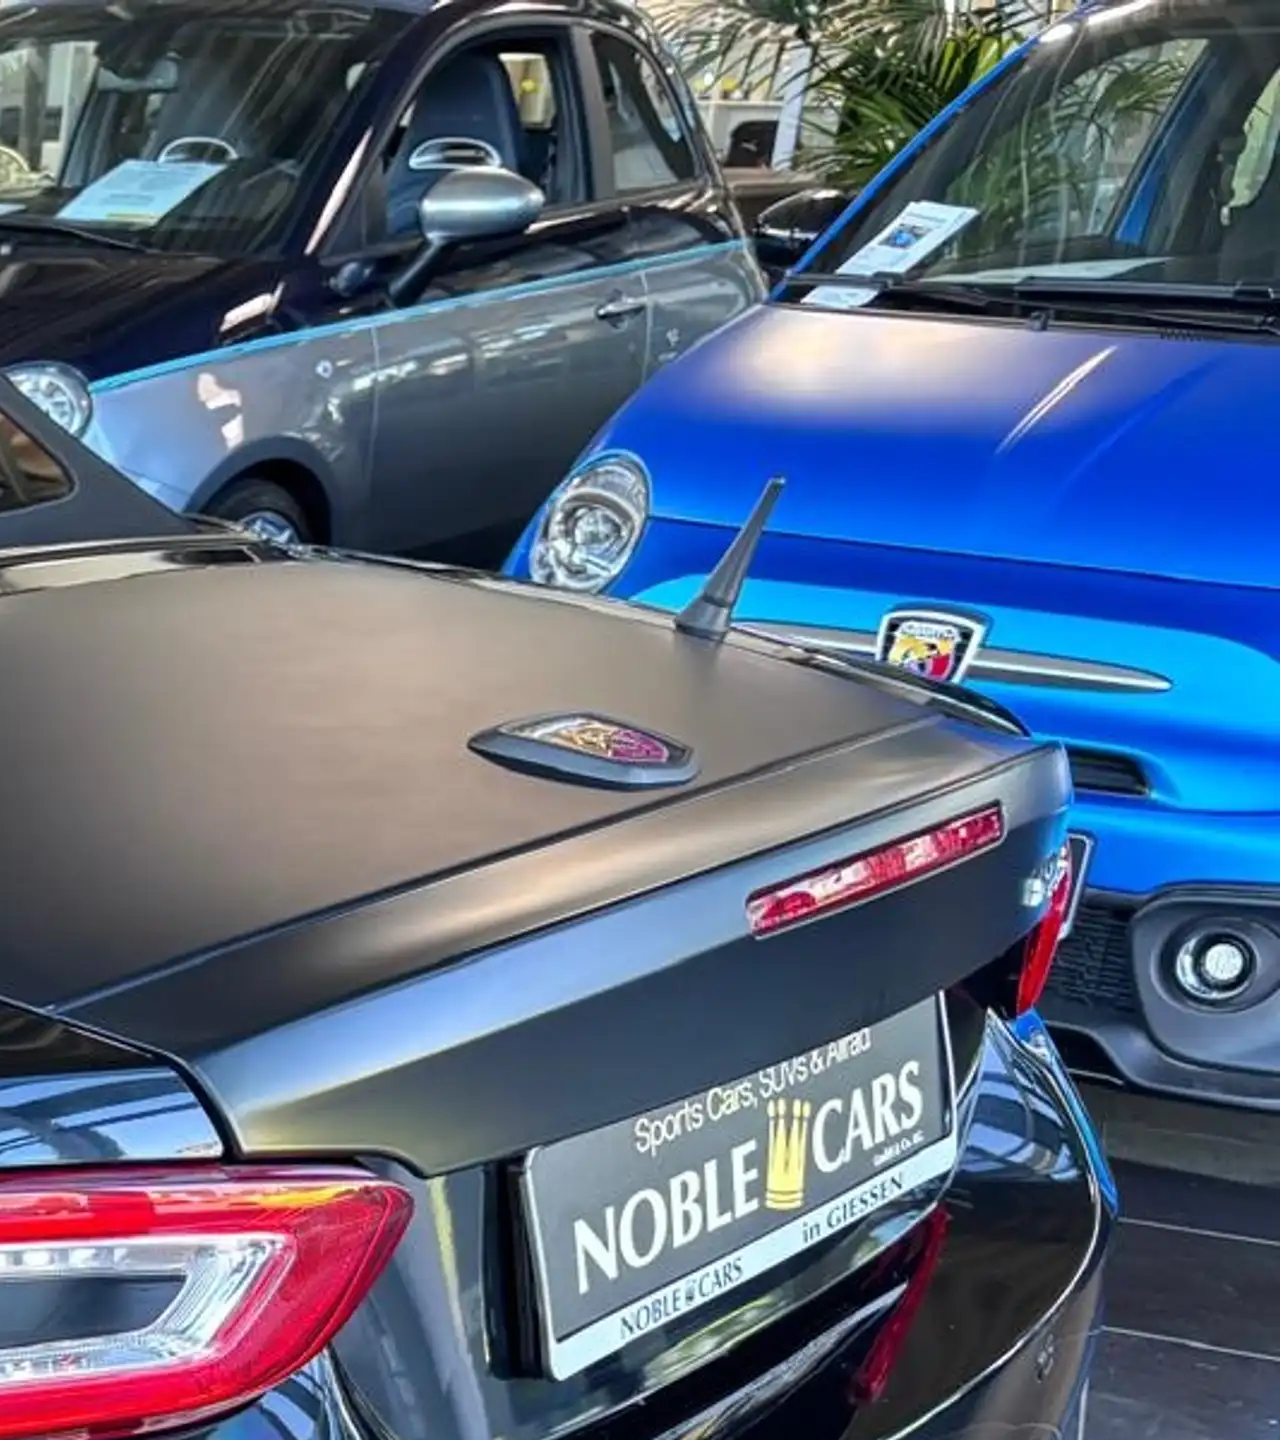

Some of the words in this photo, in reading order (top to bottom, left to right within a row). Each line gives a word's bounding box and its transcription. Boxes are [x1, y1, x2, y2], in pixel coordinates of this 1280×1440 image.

[573, 1139, 759, 1295] NOBLE
[812, 1061, 924, 1172] CARS
[635, 1100, 704, 1157] Sports
[706, 1081, 758, 1121] Cars,
[759, 1056, 808, 1098] SUVs
[810, 1051, 824, 1075] &
[619, 1287, 688, 1341] NOBLE
[698, 1257, 744, 1300] CARS
[801, 1221, 821, 1244] in
[826, 1172, 906, 1229] GIESSEN
